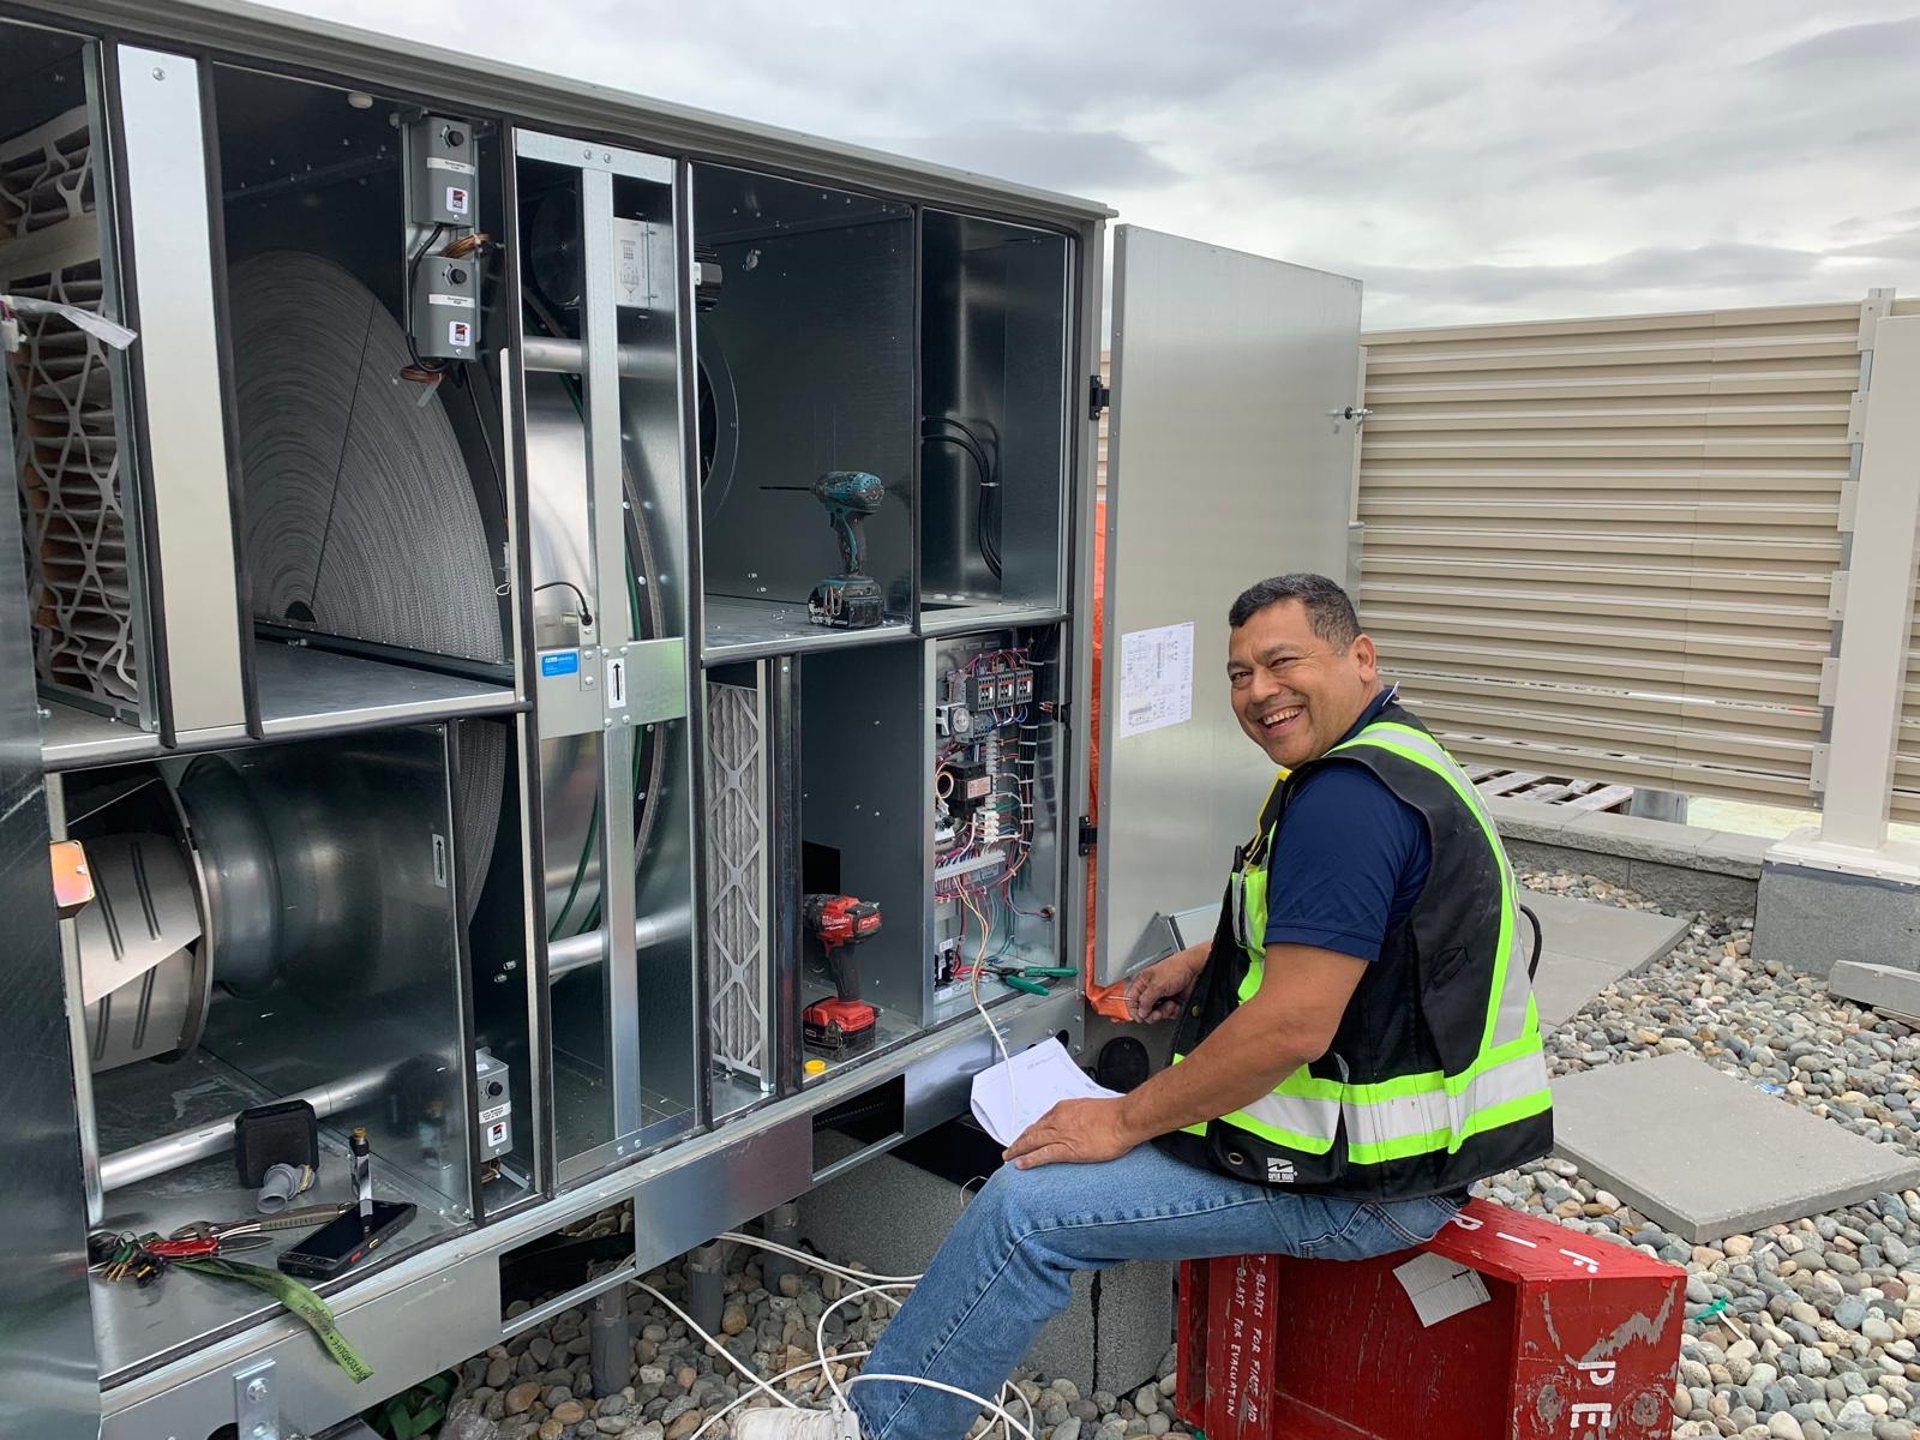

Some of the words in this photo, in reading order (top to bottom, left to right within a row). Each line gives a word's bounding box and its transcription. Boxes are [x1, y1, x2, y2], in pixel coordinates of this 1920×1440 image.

[1231, 1318, 1244, 1338] FOR
[1249, 1328, 1263, 1353] FOR
[1247, 1360, 1261, 1396] FIRST
[1246, 1397, 1258, 1423] AID
